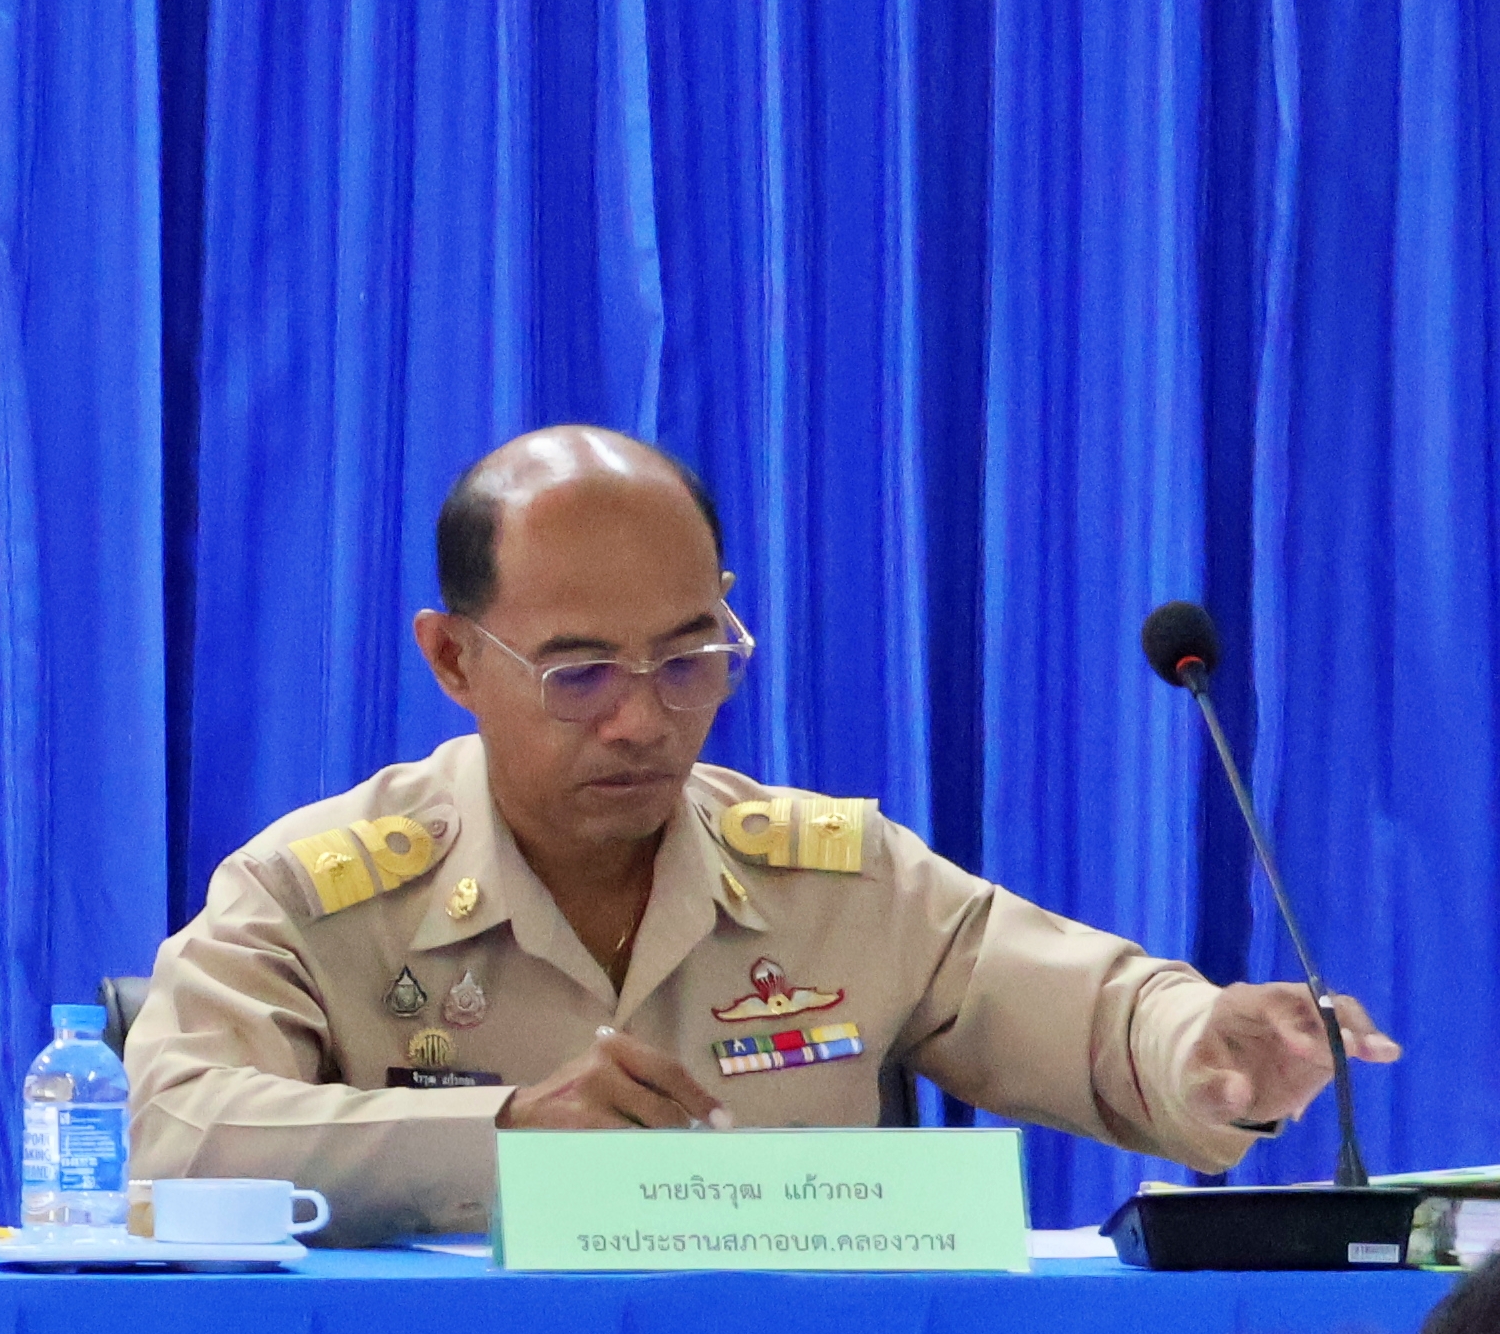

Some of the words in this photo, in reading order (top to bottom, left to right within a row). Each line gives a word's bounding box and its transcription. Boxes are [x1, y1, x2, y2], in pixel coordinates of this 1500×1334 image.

[784, 1173, 884, 1201] แก้วกอง
[575, 1228, 957, 1255] รองประธานสภาอบต.คลองวาฬ
